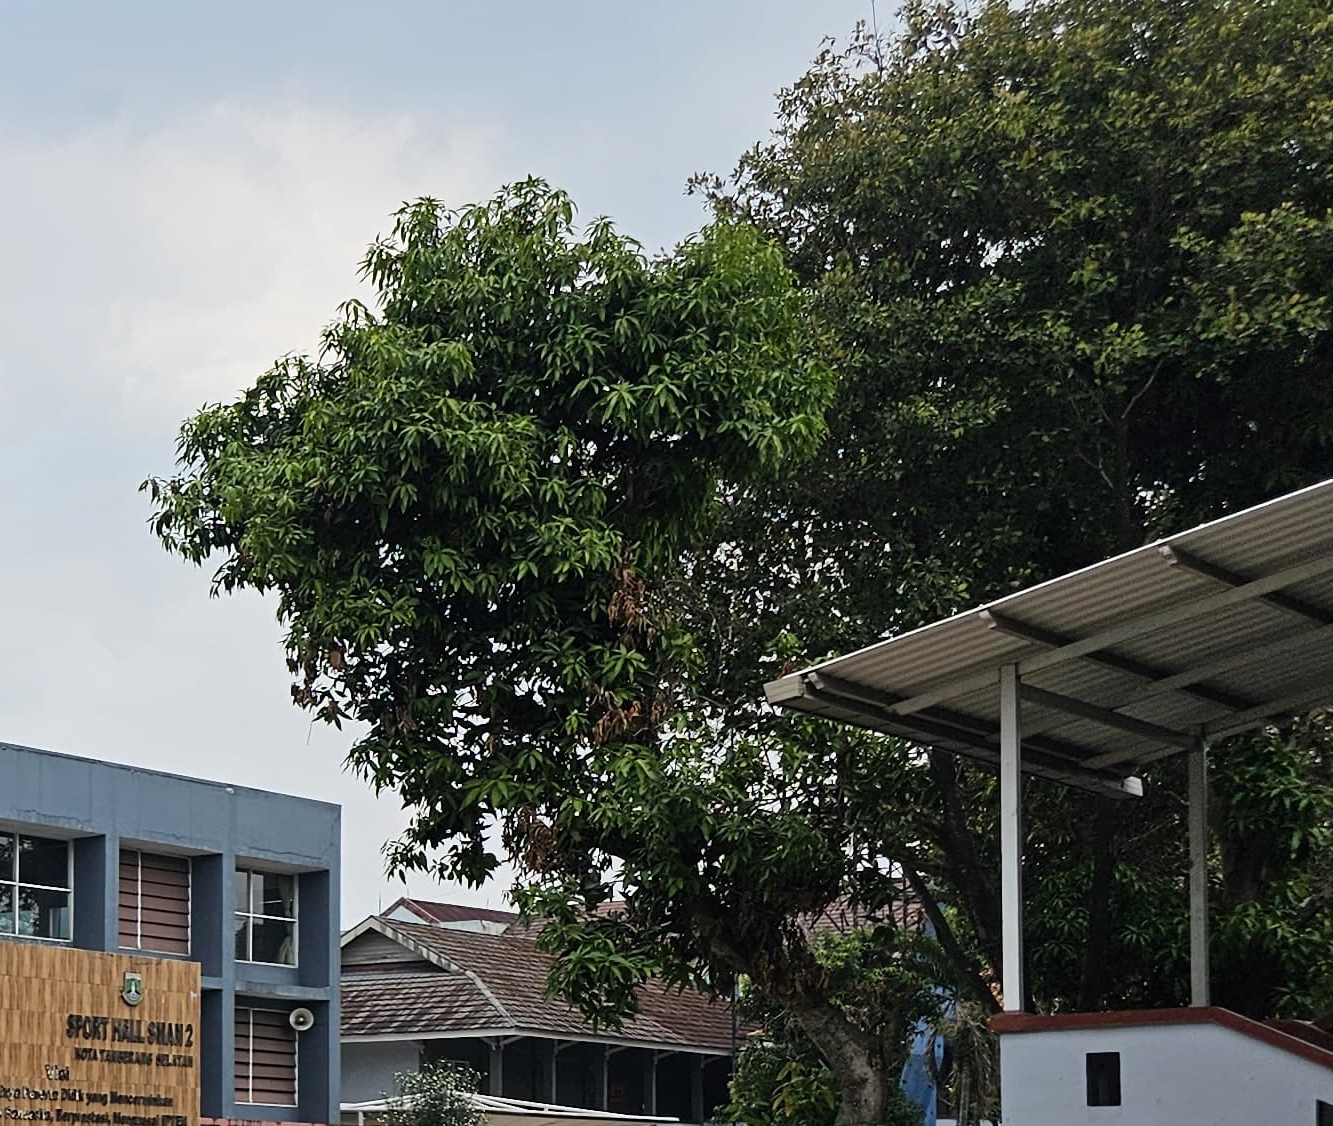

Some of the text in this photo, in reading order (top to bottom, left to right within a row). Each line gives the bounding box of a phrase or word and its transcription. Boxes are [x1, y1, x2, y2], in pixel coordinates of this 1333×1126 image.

[66, 1013, 193, 1047] SPORT HALL SMAN 2
[74, 1047, 194, 1068] KOTA TANGERANG SELATAN
[86, 1092, 108, 1106] yang
